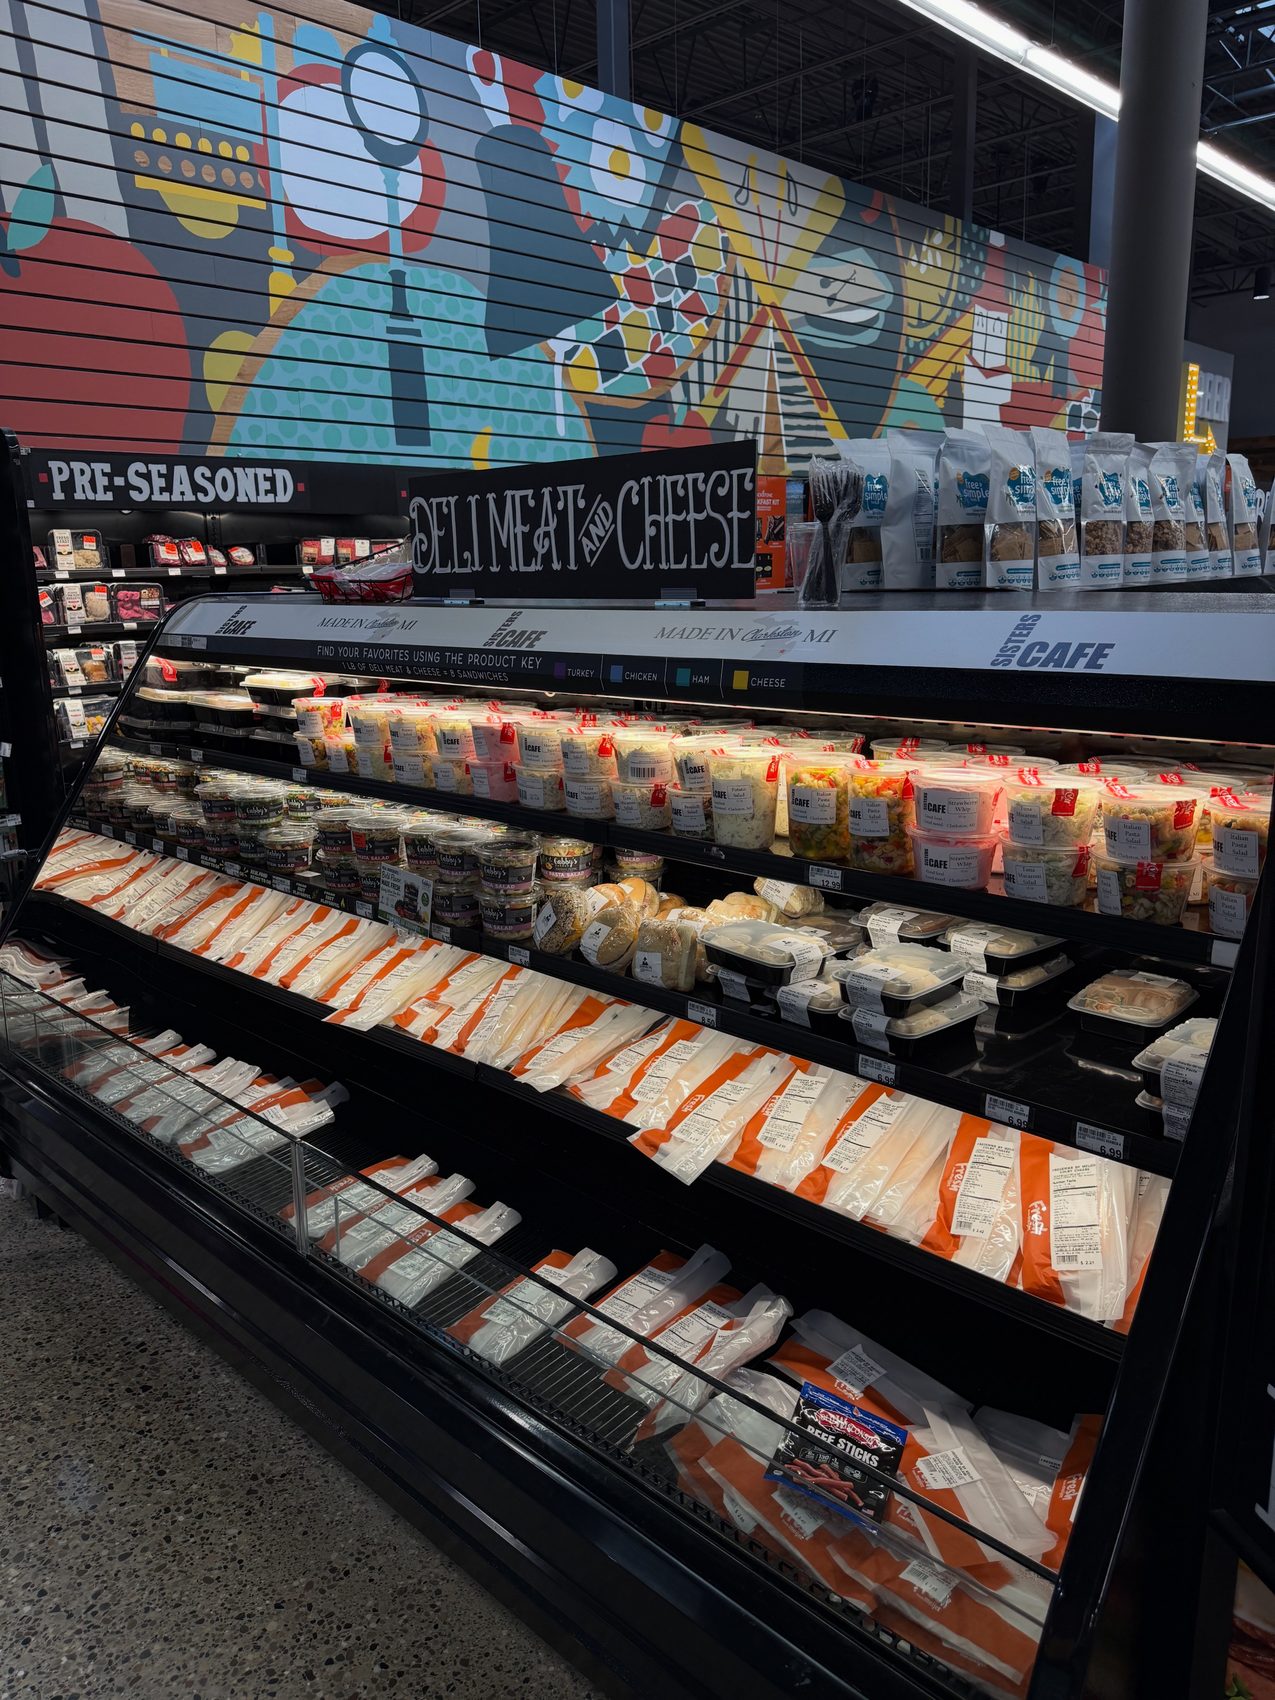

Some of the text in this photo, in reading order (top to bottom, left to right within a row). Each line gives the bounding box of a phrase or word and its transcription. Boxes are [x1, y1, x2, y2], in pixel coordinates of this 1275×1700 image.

[48, 461, 294, 503] PRE-SEASONED
[409, 468, 754, 574] DELI MEAT AND CHEESE
[224, 620, 256, 635] CAFE
[317, 617, 349, 628] MADE
[349, 618, 369, 629] IN
[398, 619, 418, 630] MI
[482, 610, 523, 647] SISTERS
[495, 629, 548, 648] CAFE
[654, 627, 713, 640] MADE
[714, 628, 742, 641] IN
[801, 629, 839, 643] MI
[990, 614, 1042, 667] SISTERS
[317, 645, 542, 670] FIND YOUR FAVORITES USING THE PRODUCT KEY
[1016, 641, 1116, 670] CAFE
[347, 662, 356, 671] LB
[357, 663, 366, 671] OF
[368, 663, 385, 673] DELI
[385, 664, 403, 674] MEAT
[412, 666, 441, 676] CHEESE
[450, 669, 456, 677] 8
[457, 669, 509, 682] SANDWICHES
[566, 667, 595, 677] TURKEY
[624, 671, 658, 681] CHICKEN
[692, 675, 710, 684] HAM
[750, 677, 786, 688] CHEESE
[528, 744, 541, 753] CAFE
[689, 765, 705, 774] CAFE
[567, 790, 578, 800] CAFE
[714, 790, 727, 799] CAFE
[794, 797, 809, 807] CAFE
[927, 802, 946, 814] CAFE
[554, 857, 577, 868] Gabby's
[928, 858, 948, 869] CAFE
[821, 880, 840, 889] 12.99
[701, 1016, 715, 1028] 8.50
[878, 1073, 896, 1086] 6.99
[1007, 1115, 1029, 1129] 6.99
[1100, 1145, 1121, 1159] 6.99
[1029, 1200, 1048, 1235] Fresh
[807, 1425, 880, 1467] BEEF STICKS
[1062, 1473, 1082, 1500] Fresh
